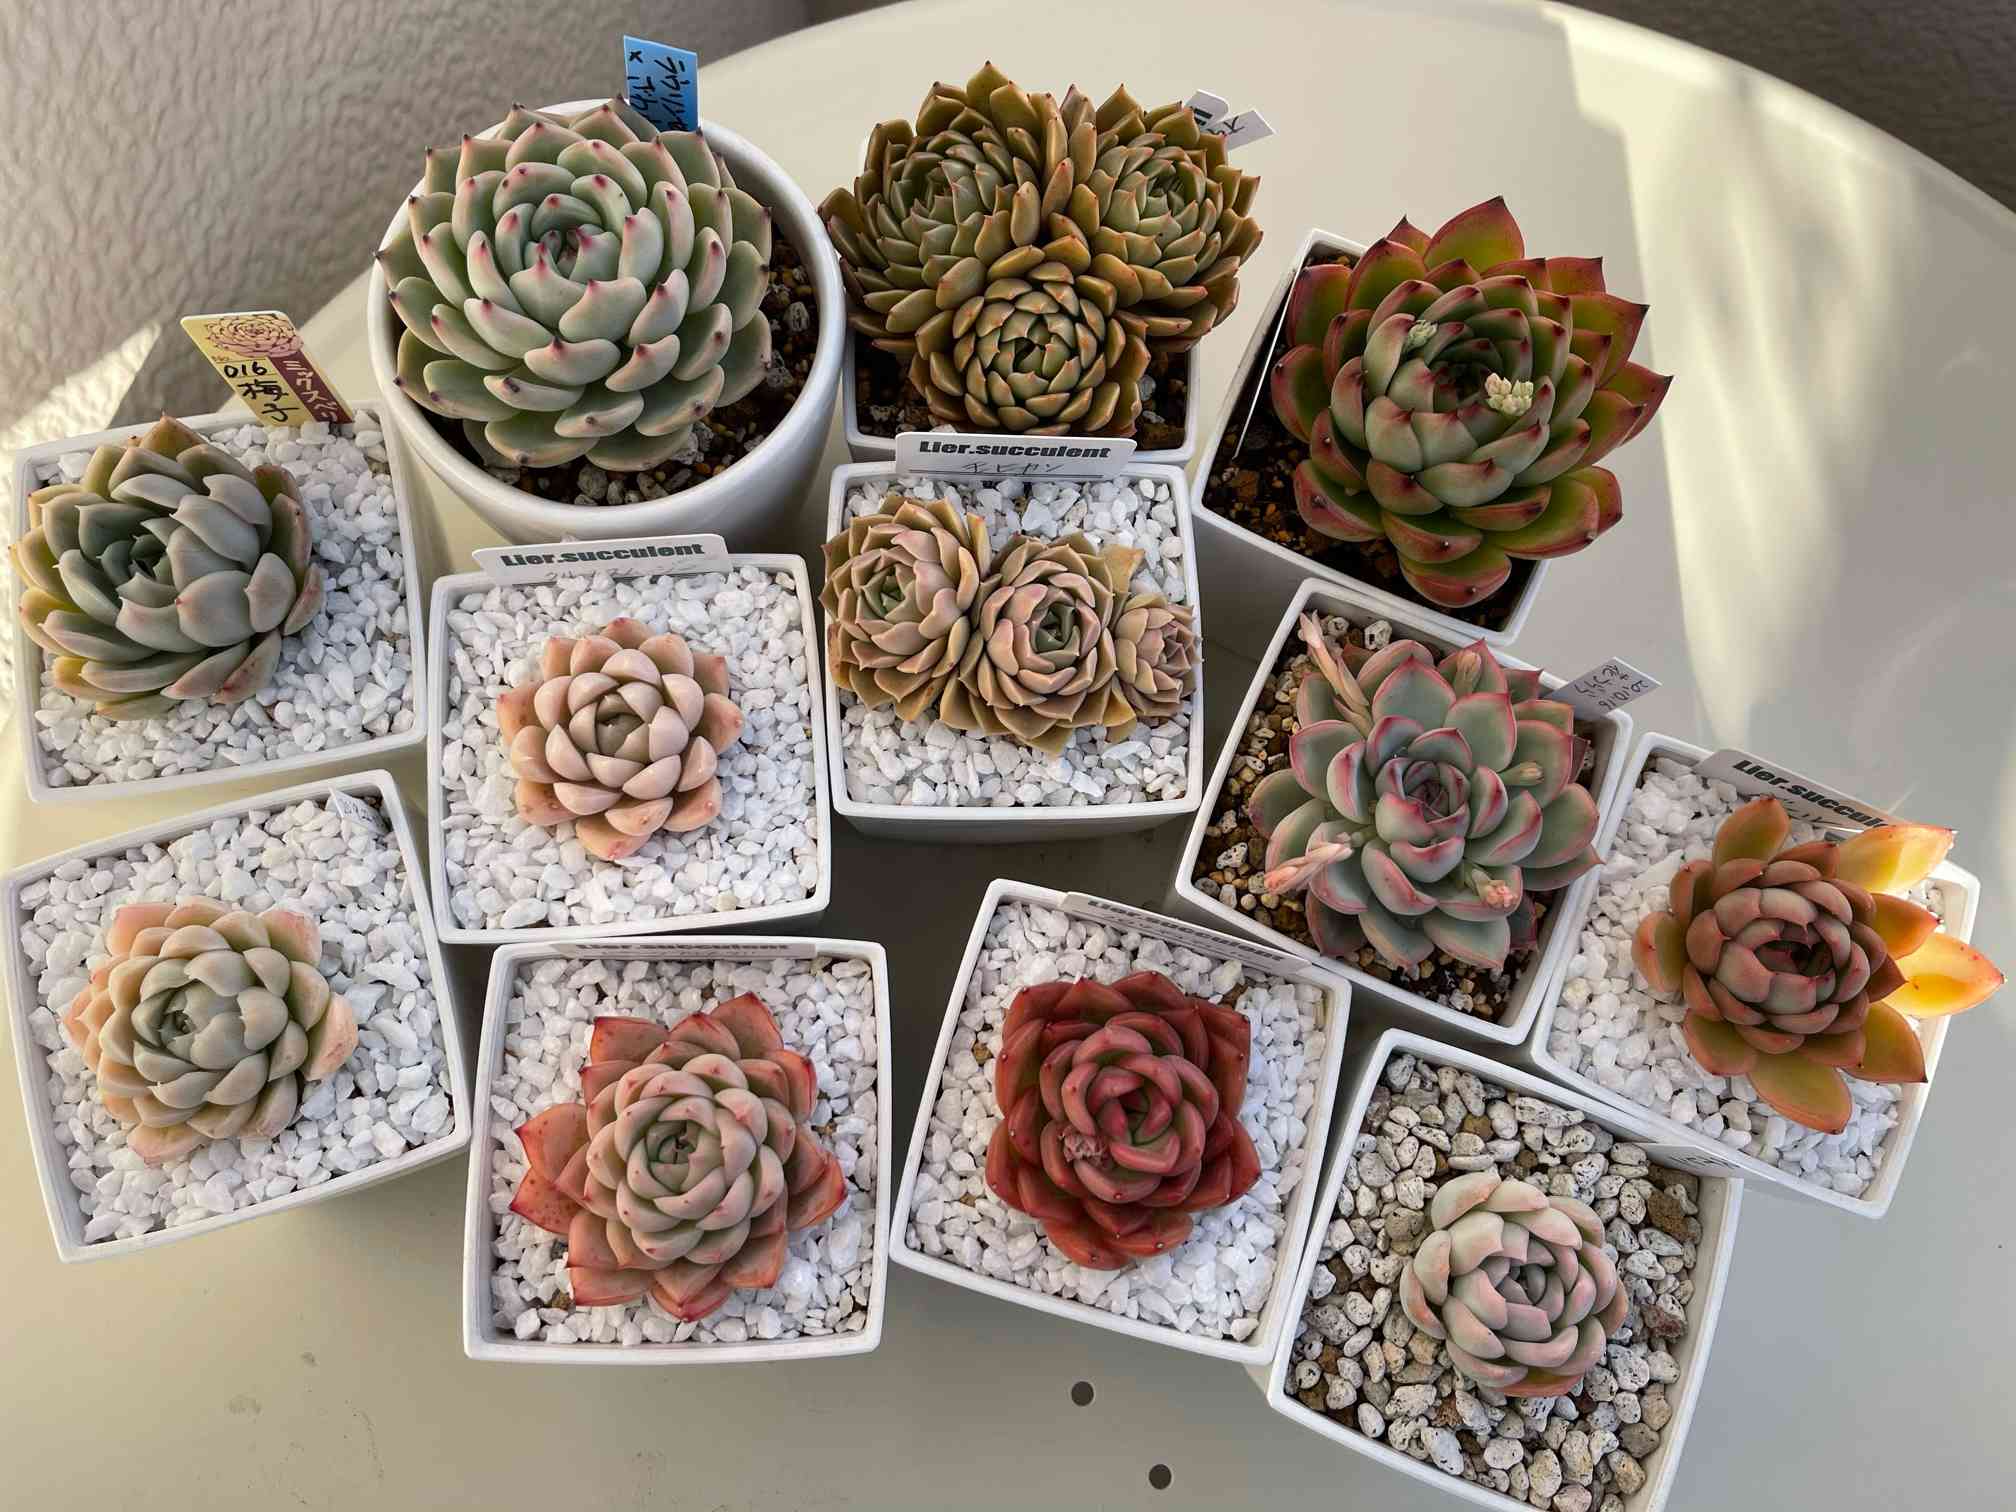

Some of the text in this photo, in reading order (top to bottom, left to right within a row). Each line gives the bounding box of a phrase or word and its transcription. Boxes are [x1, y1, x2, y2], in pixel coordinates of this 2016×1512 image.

[223, 361, 267, 378] 016
[919, 440, 1111, 459] Lier.succulent
[500, 543, 705, 567] Lier.succulent
